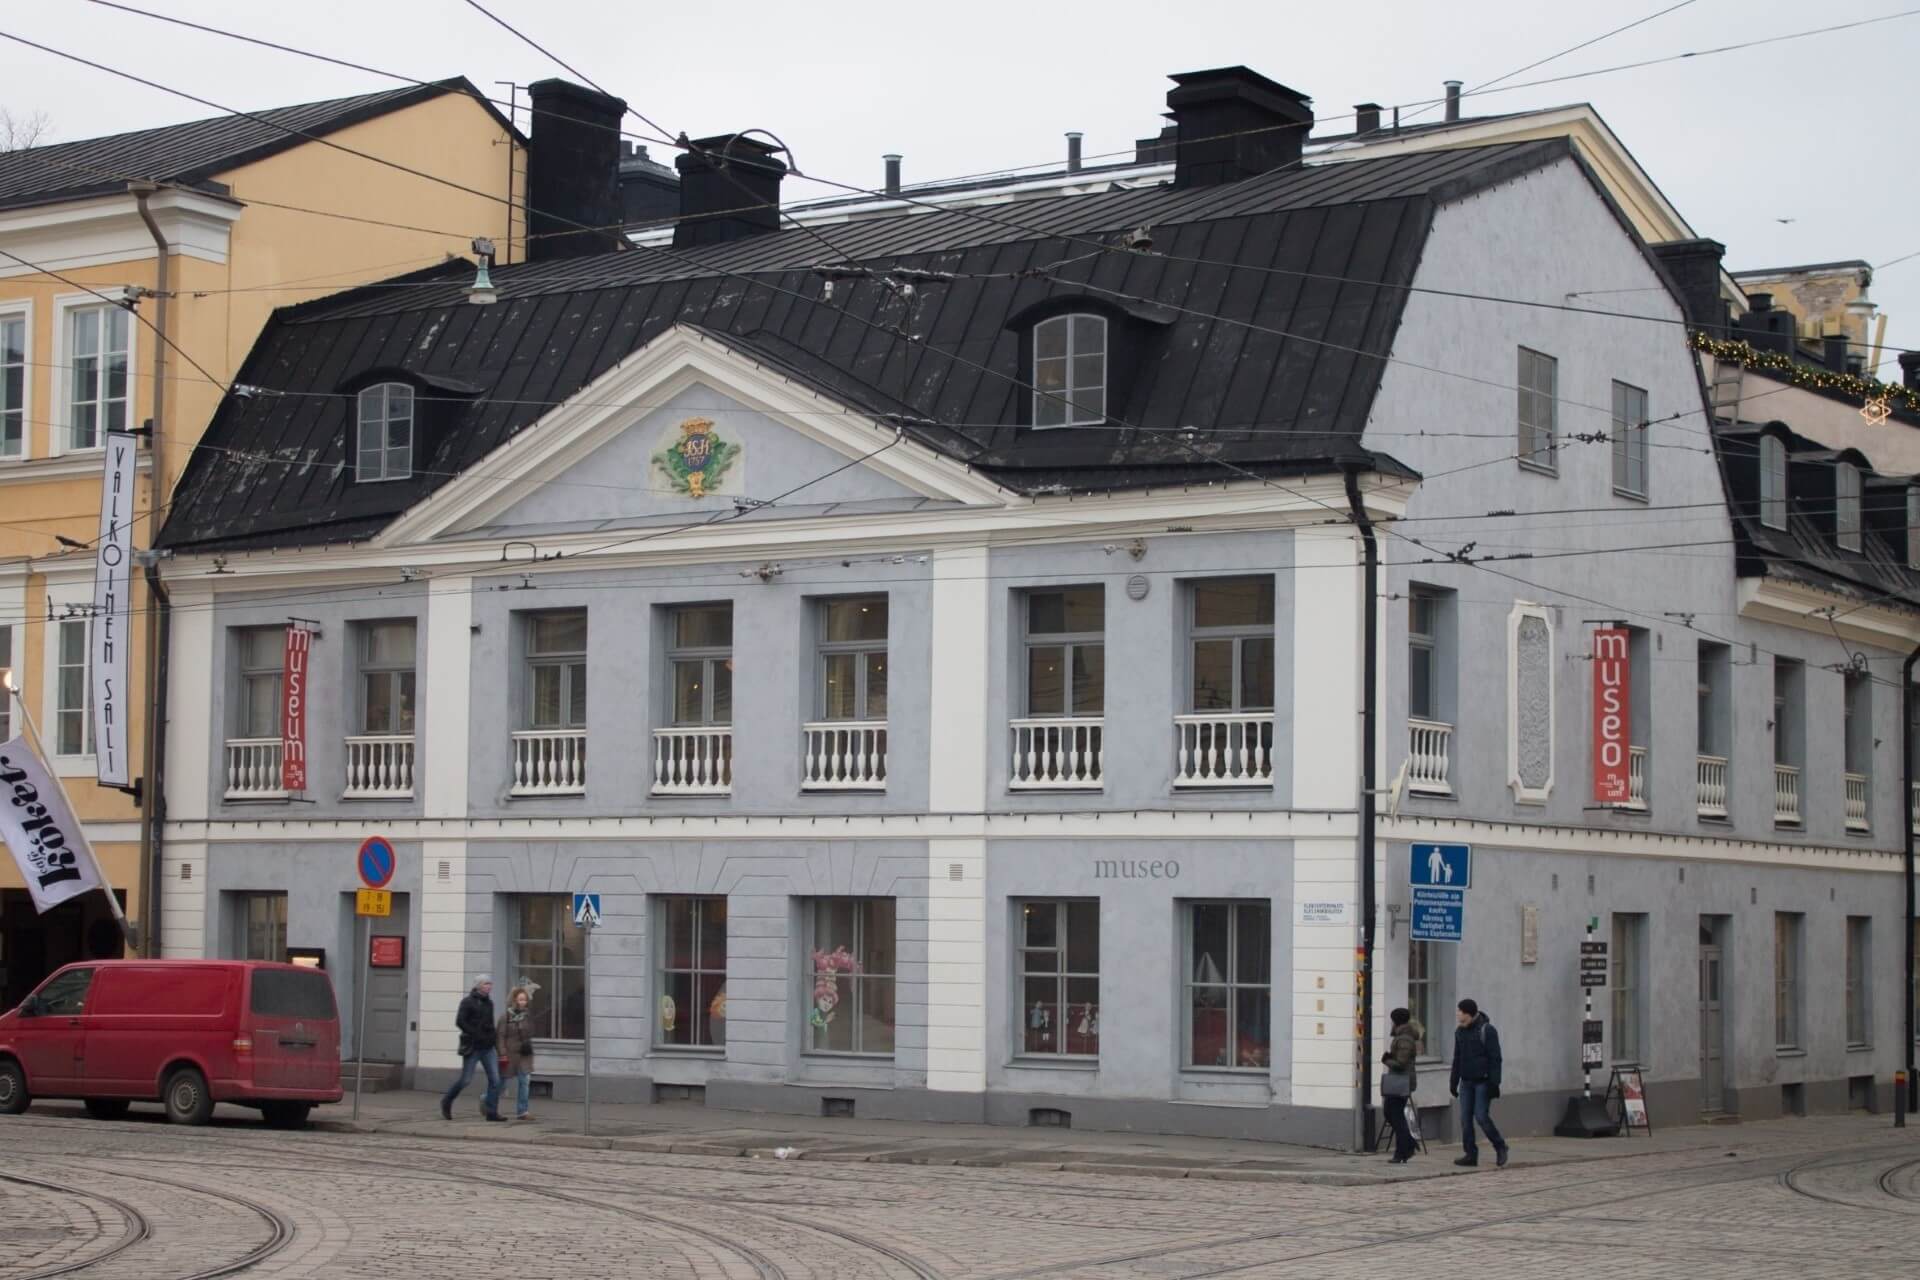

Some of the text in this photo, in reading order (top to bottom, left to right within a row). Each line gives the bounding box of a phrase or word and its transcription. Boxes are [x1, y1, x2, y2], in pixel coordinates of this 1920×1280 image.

[102, 446, 125, 773] VALKOINEN SALI
[284, 628, 308, 761] museum
[1596, 634, 1626, 767] museo
[1093, 859, 1180, 879] museo
